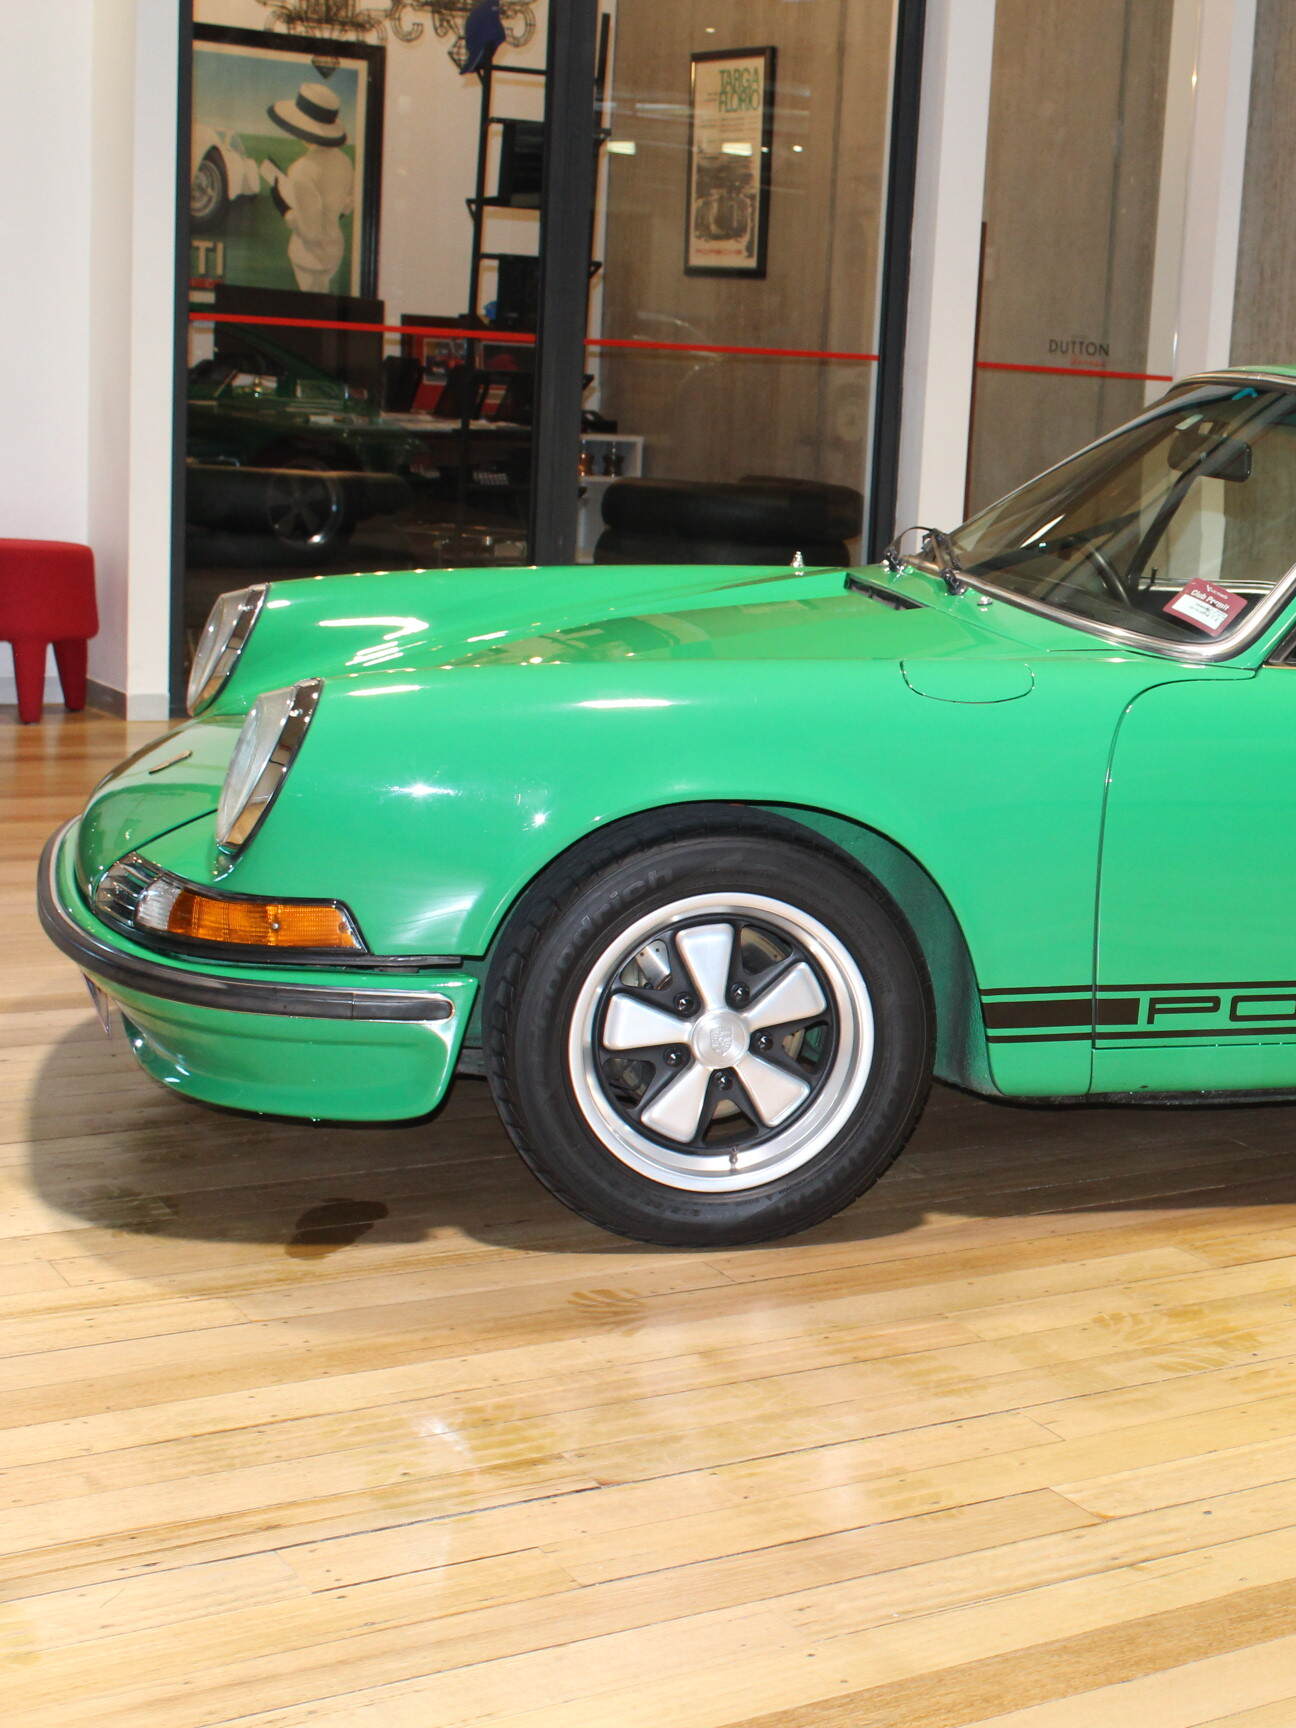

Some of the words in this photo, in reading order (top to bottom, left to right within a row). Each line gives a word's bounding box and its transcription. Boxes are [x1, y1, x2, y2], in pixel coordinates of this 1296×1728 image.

[719, 67, 760, 91] TARGA
[718, 88, 760, 112] FLORIO
[192, 240, 223, 275] TI
[1048, 339, 1110, 357] DUTTON
[1190, 589, 1207, 600] Club
[1206, 596, 1231, 611] Permit
